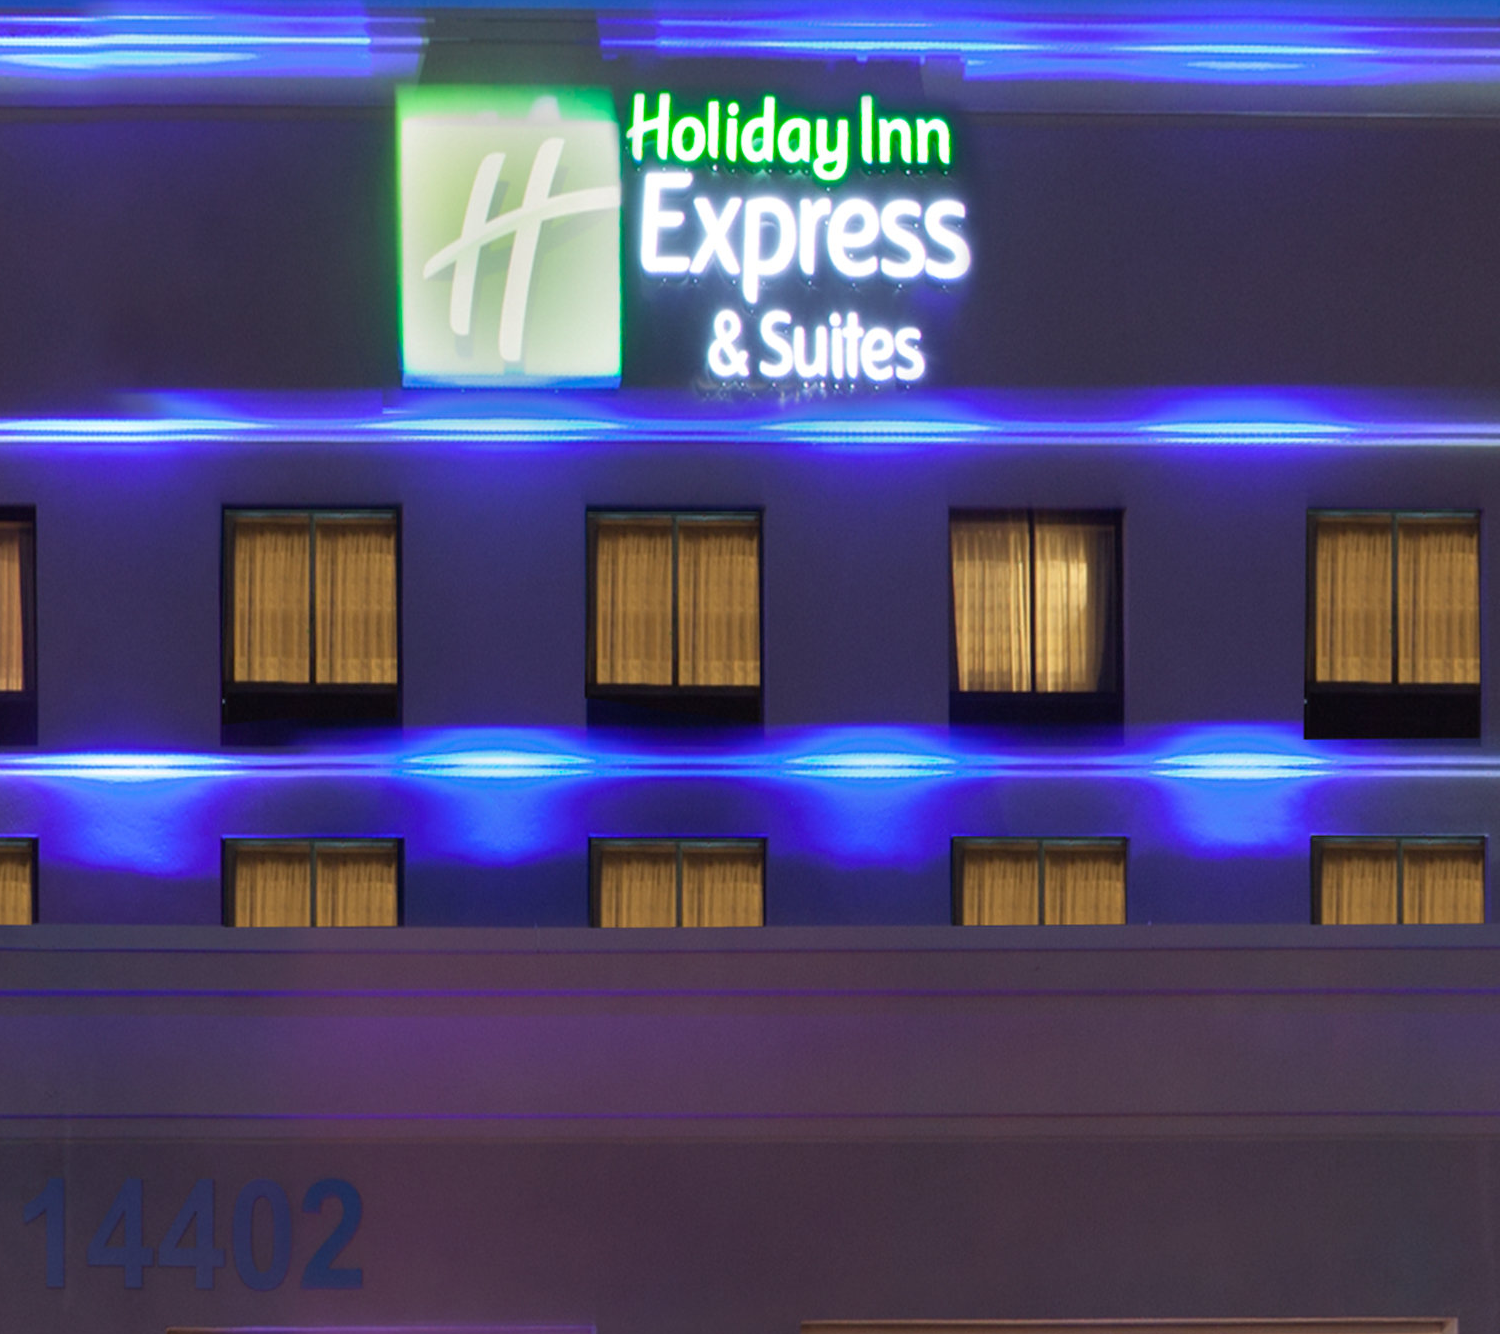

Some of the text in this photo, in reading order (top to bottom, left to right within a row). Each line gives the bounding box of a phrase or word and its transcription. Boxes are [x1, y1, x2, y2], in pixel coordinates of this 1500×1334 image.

[626, 91, 951, 181] Holiday Inn
[638, 171, 972, 304] Express
[707, 308, 926, 381] & Suites
[22, 1177, 364, 1292] 14402
